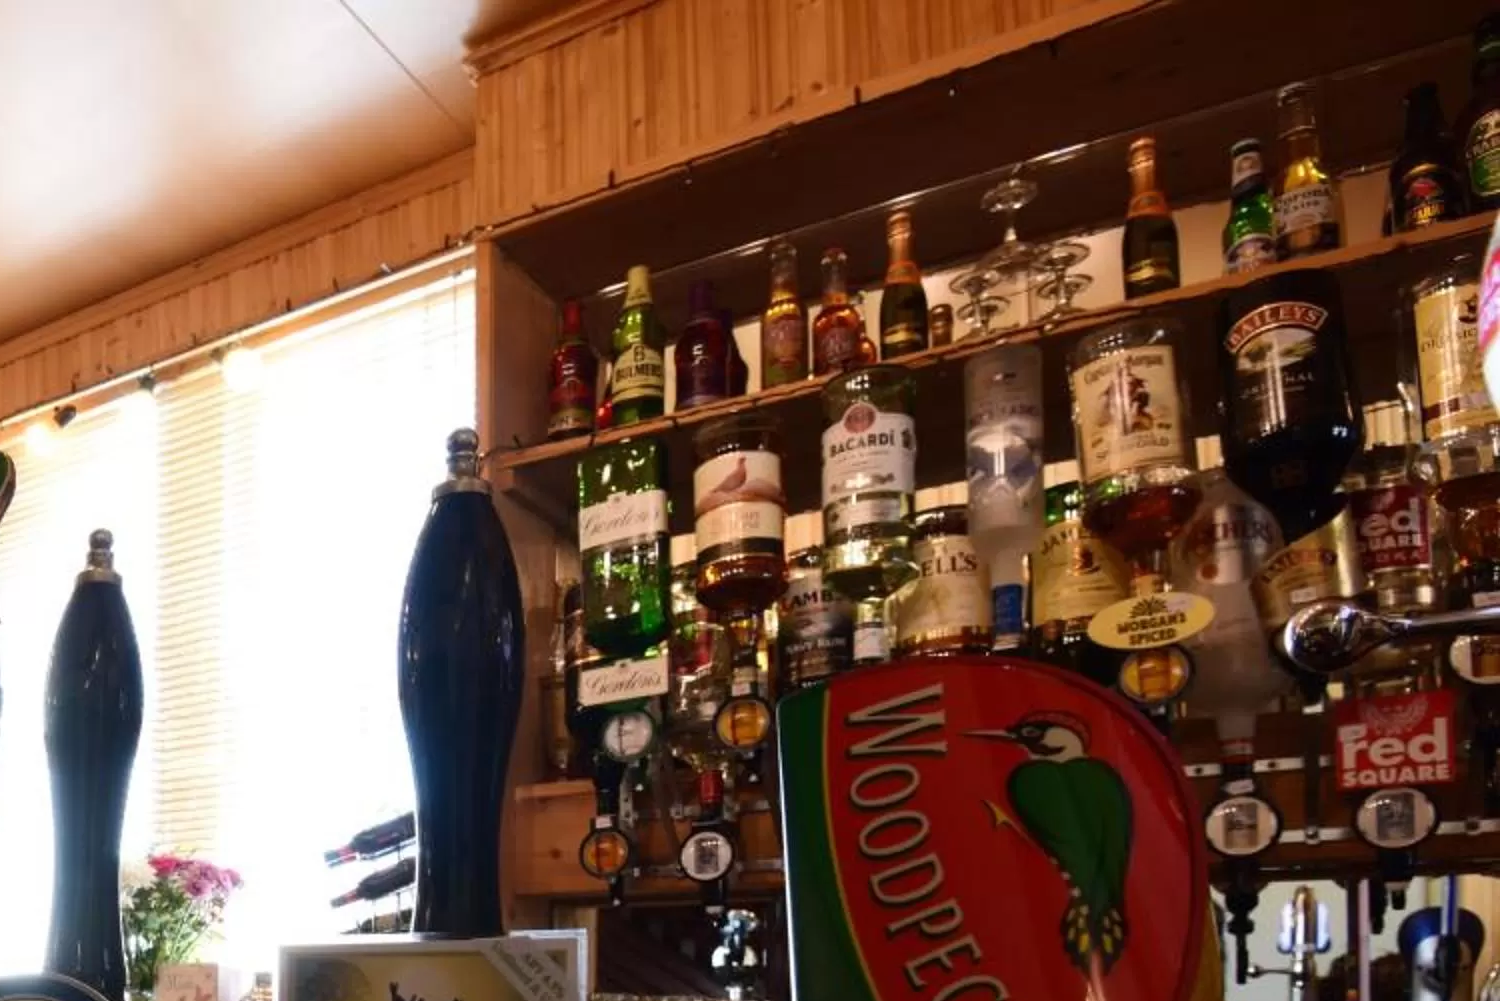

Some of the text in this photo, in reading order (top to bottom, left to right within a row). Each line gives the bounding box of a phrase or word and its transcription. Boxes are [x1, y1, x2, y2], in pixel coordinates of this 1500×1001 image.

[1230, 307, 1317, 345] BAILEYS
[1361, 497, 1419, 536] ed
[920, 552, 978, 576] ELL'S
[1343, 716, 1448, 769] red
[1343, 763, 1450, 787] SQUARE
